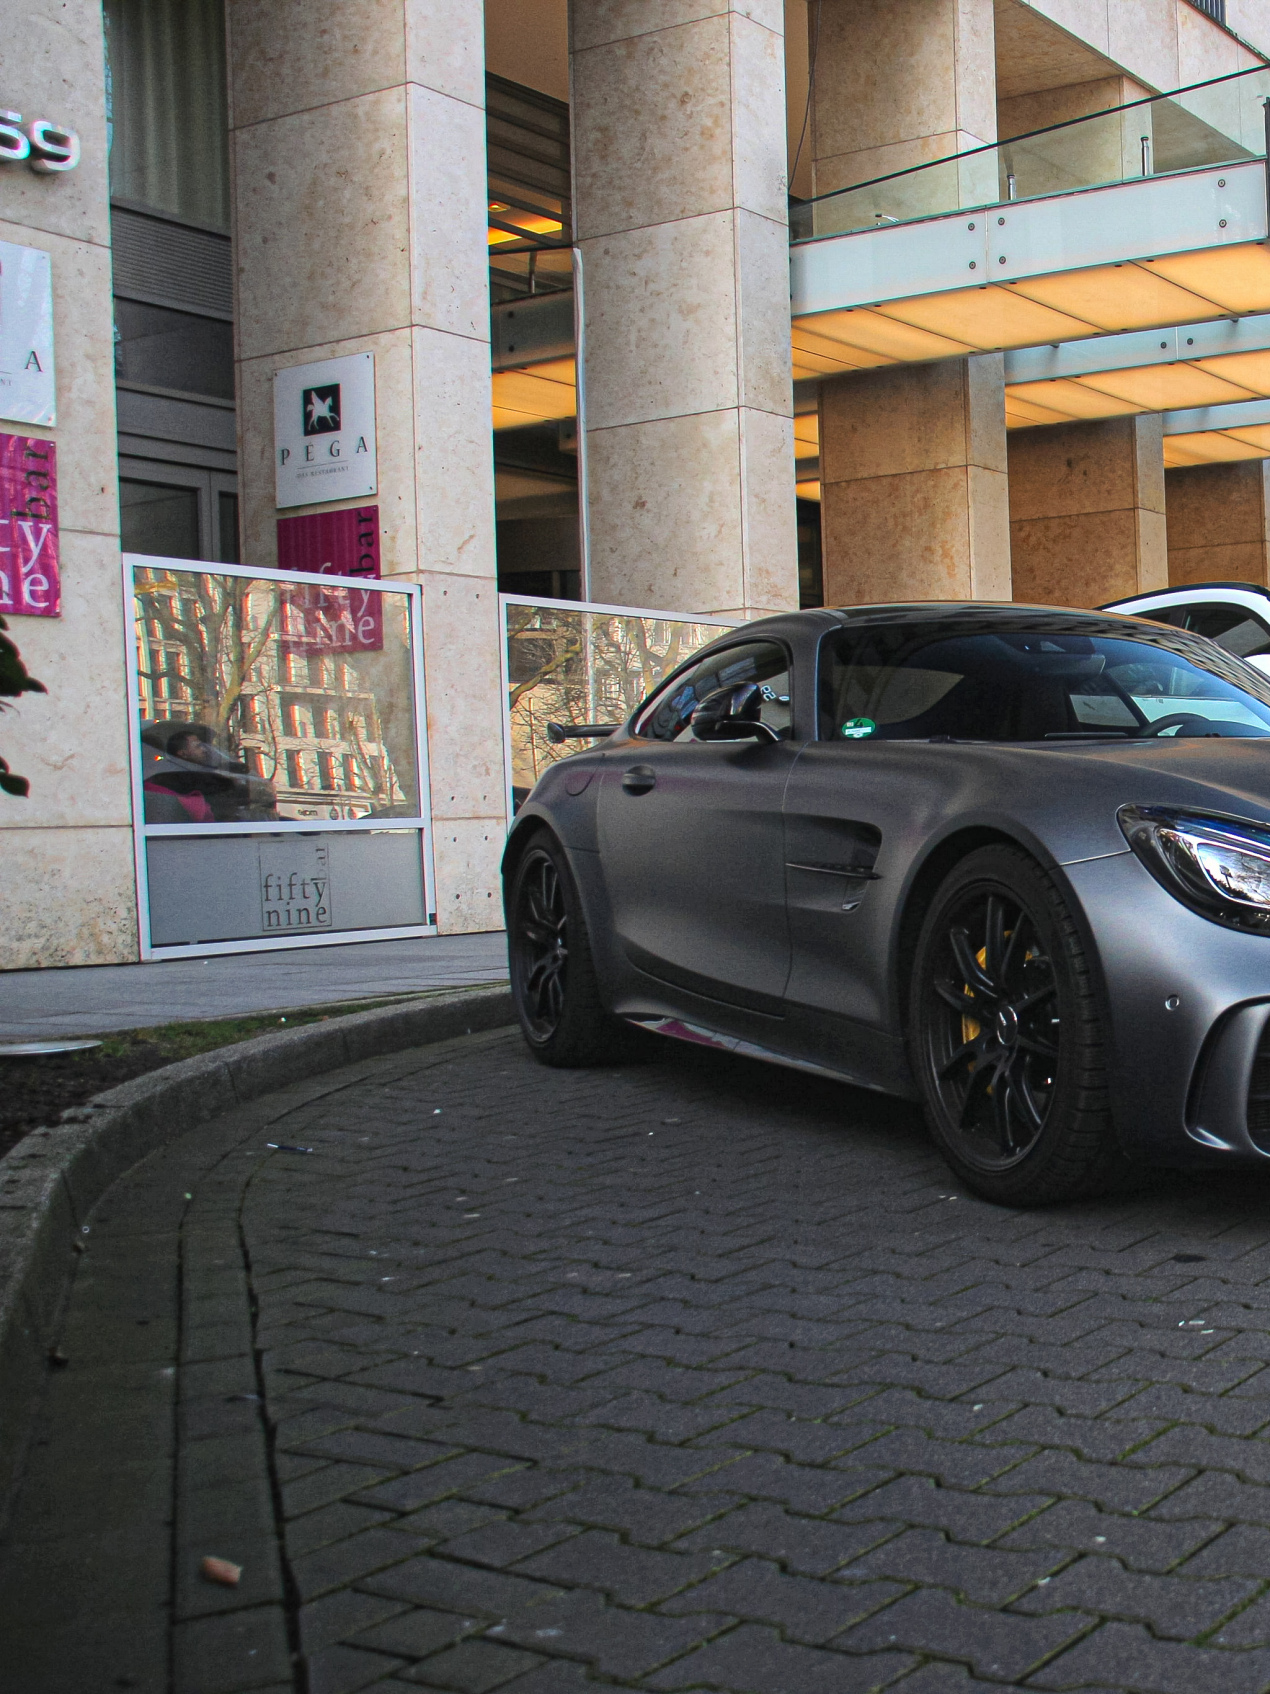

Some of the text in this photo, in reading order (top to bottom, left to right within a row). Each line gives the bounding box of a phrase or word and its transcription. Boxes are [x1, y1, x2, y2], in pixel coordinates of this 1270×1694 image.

[11, 442, 50, 519] bar
[349, 510, 375, 573] bar
[263, 872, 327, 907] fifty
[265, 902, 327, 927] nine
